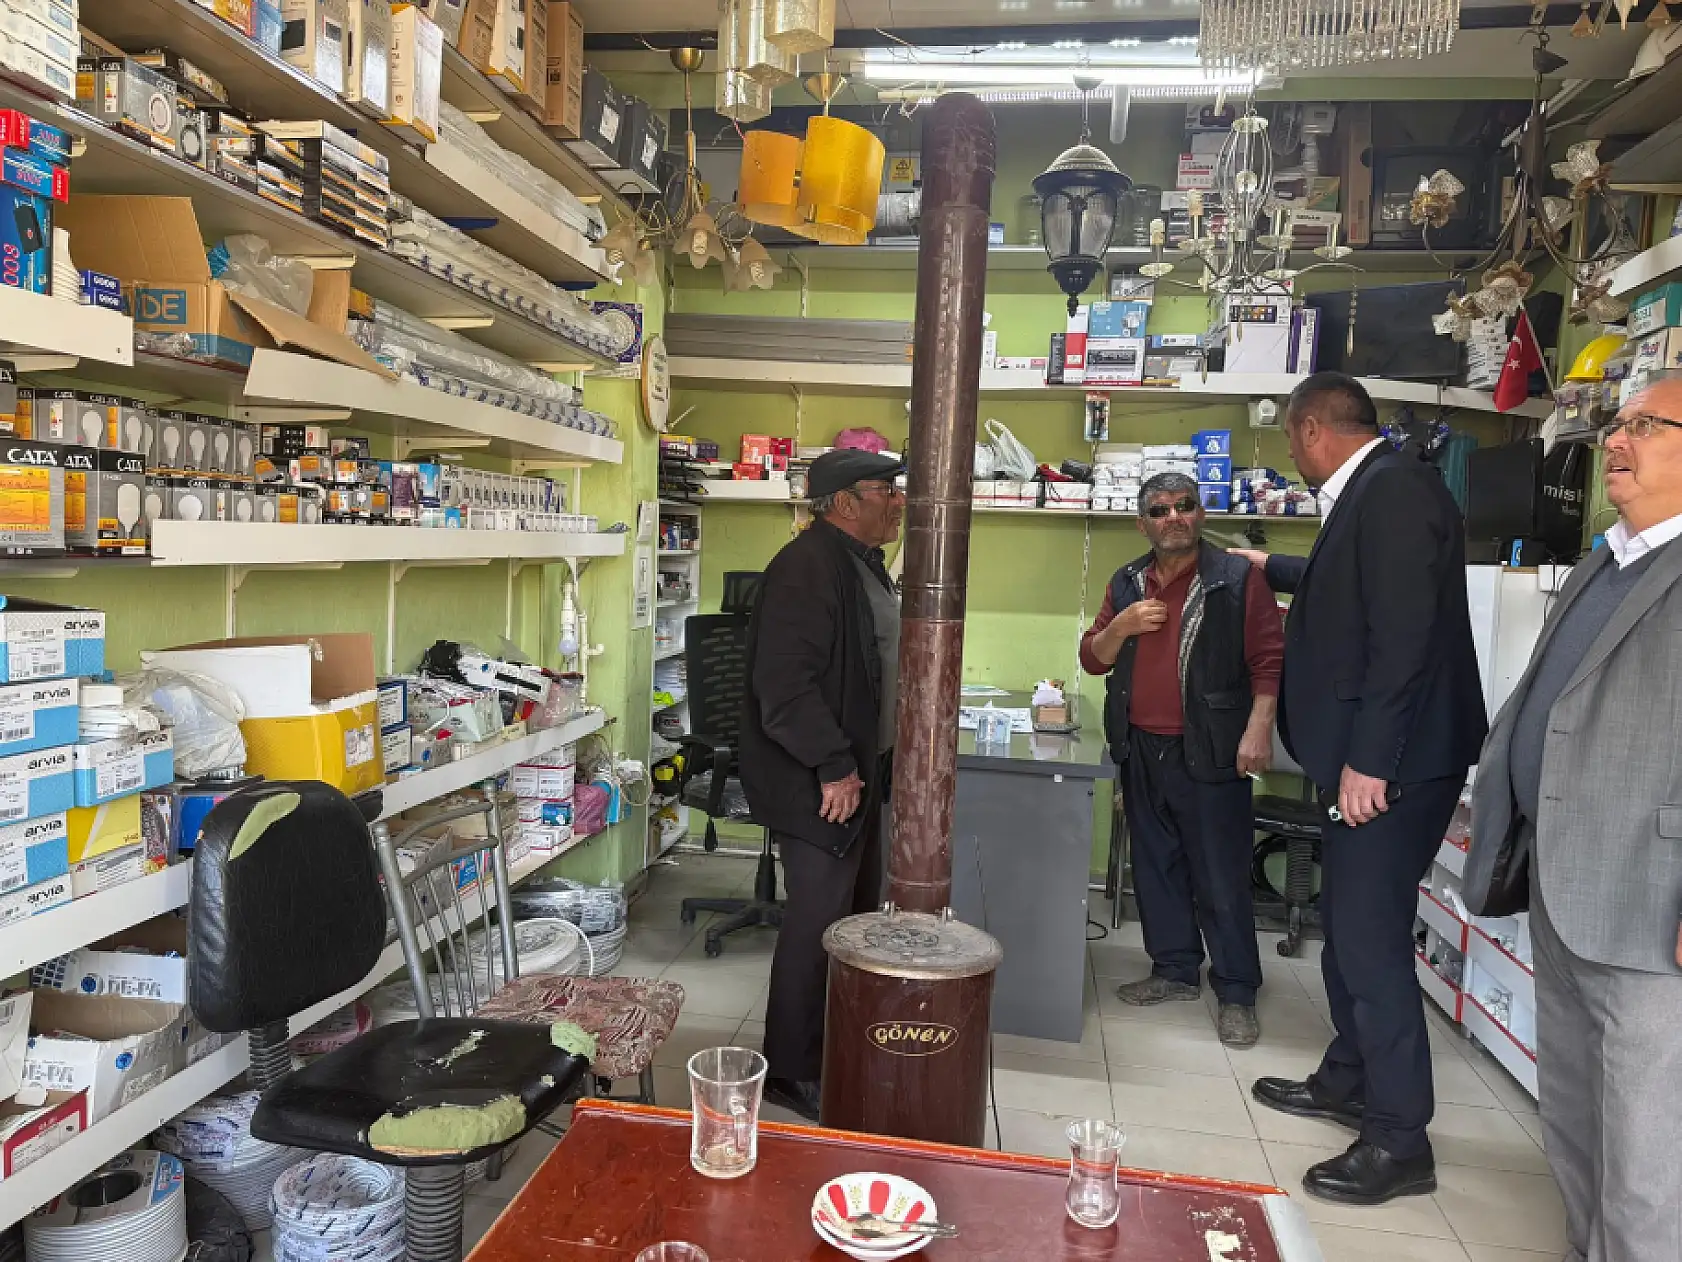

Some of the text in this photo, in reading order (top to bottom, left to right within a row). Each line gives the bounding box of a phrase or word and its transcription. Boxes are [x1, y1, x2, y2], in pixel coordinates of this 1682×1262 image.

[141, 294, 180, 321] DE
[7, 448, 57, 466] CATA
[64, 452, 92, 470] ATA
[64, 619, 99, 630] arvia
[33, 687, 70, 701] arvia
[141, 733, 168, 746] rvia
[27, 753, 65, 770] arvia
[25, 820, 62, 838] arvia
[27, 884, 64, 903] arvia
